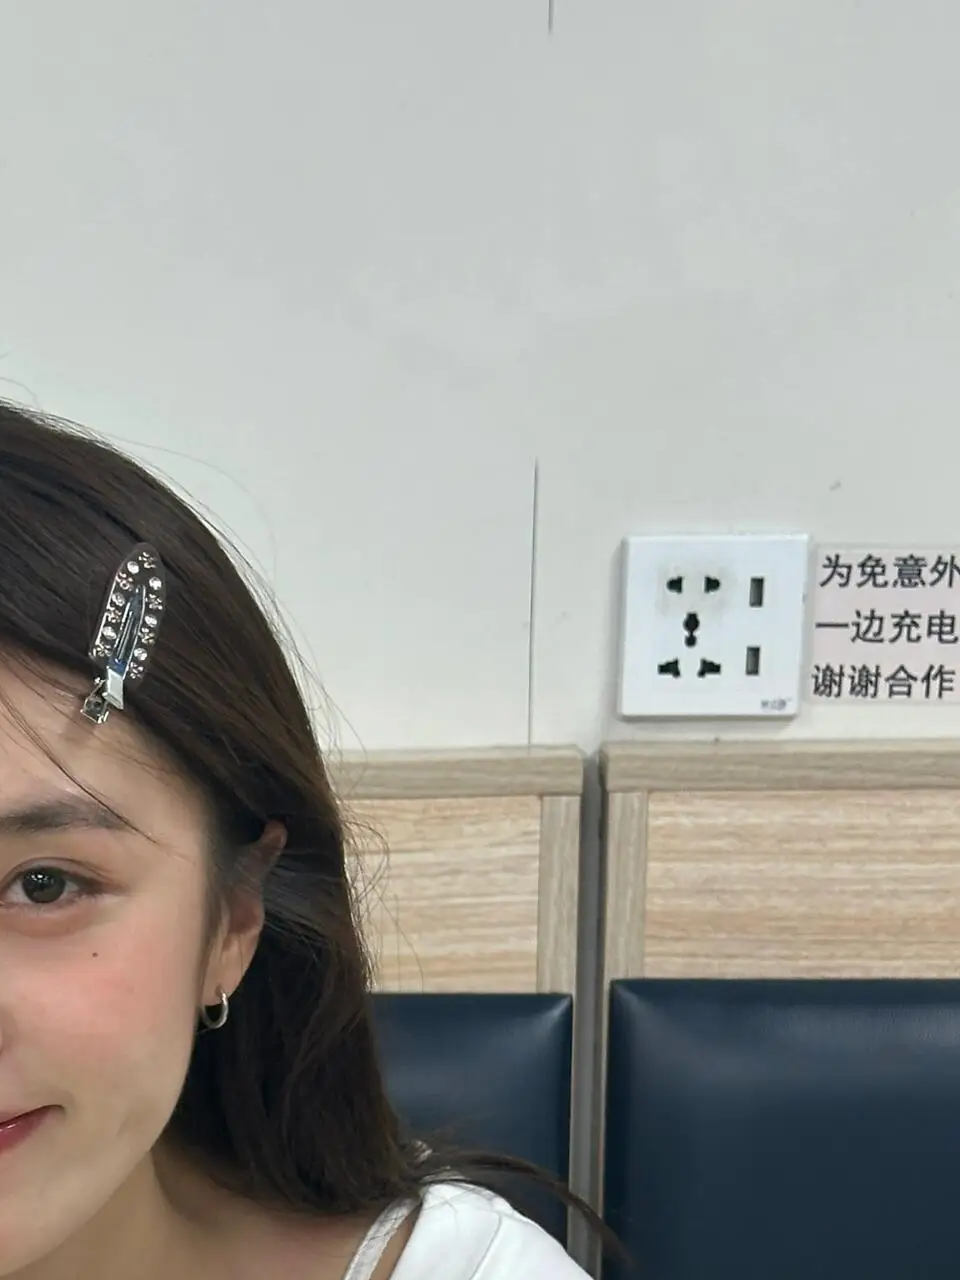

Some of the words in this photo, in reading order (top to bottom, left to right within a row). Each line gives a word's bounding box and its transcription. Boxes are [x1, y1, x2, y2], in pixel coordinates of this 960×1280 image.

[820, 553, 960, 588] 为免意外
[815, 608, 959, 643] 一边充电
[811, 664, 956, 698] 谢谢合作
